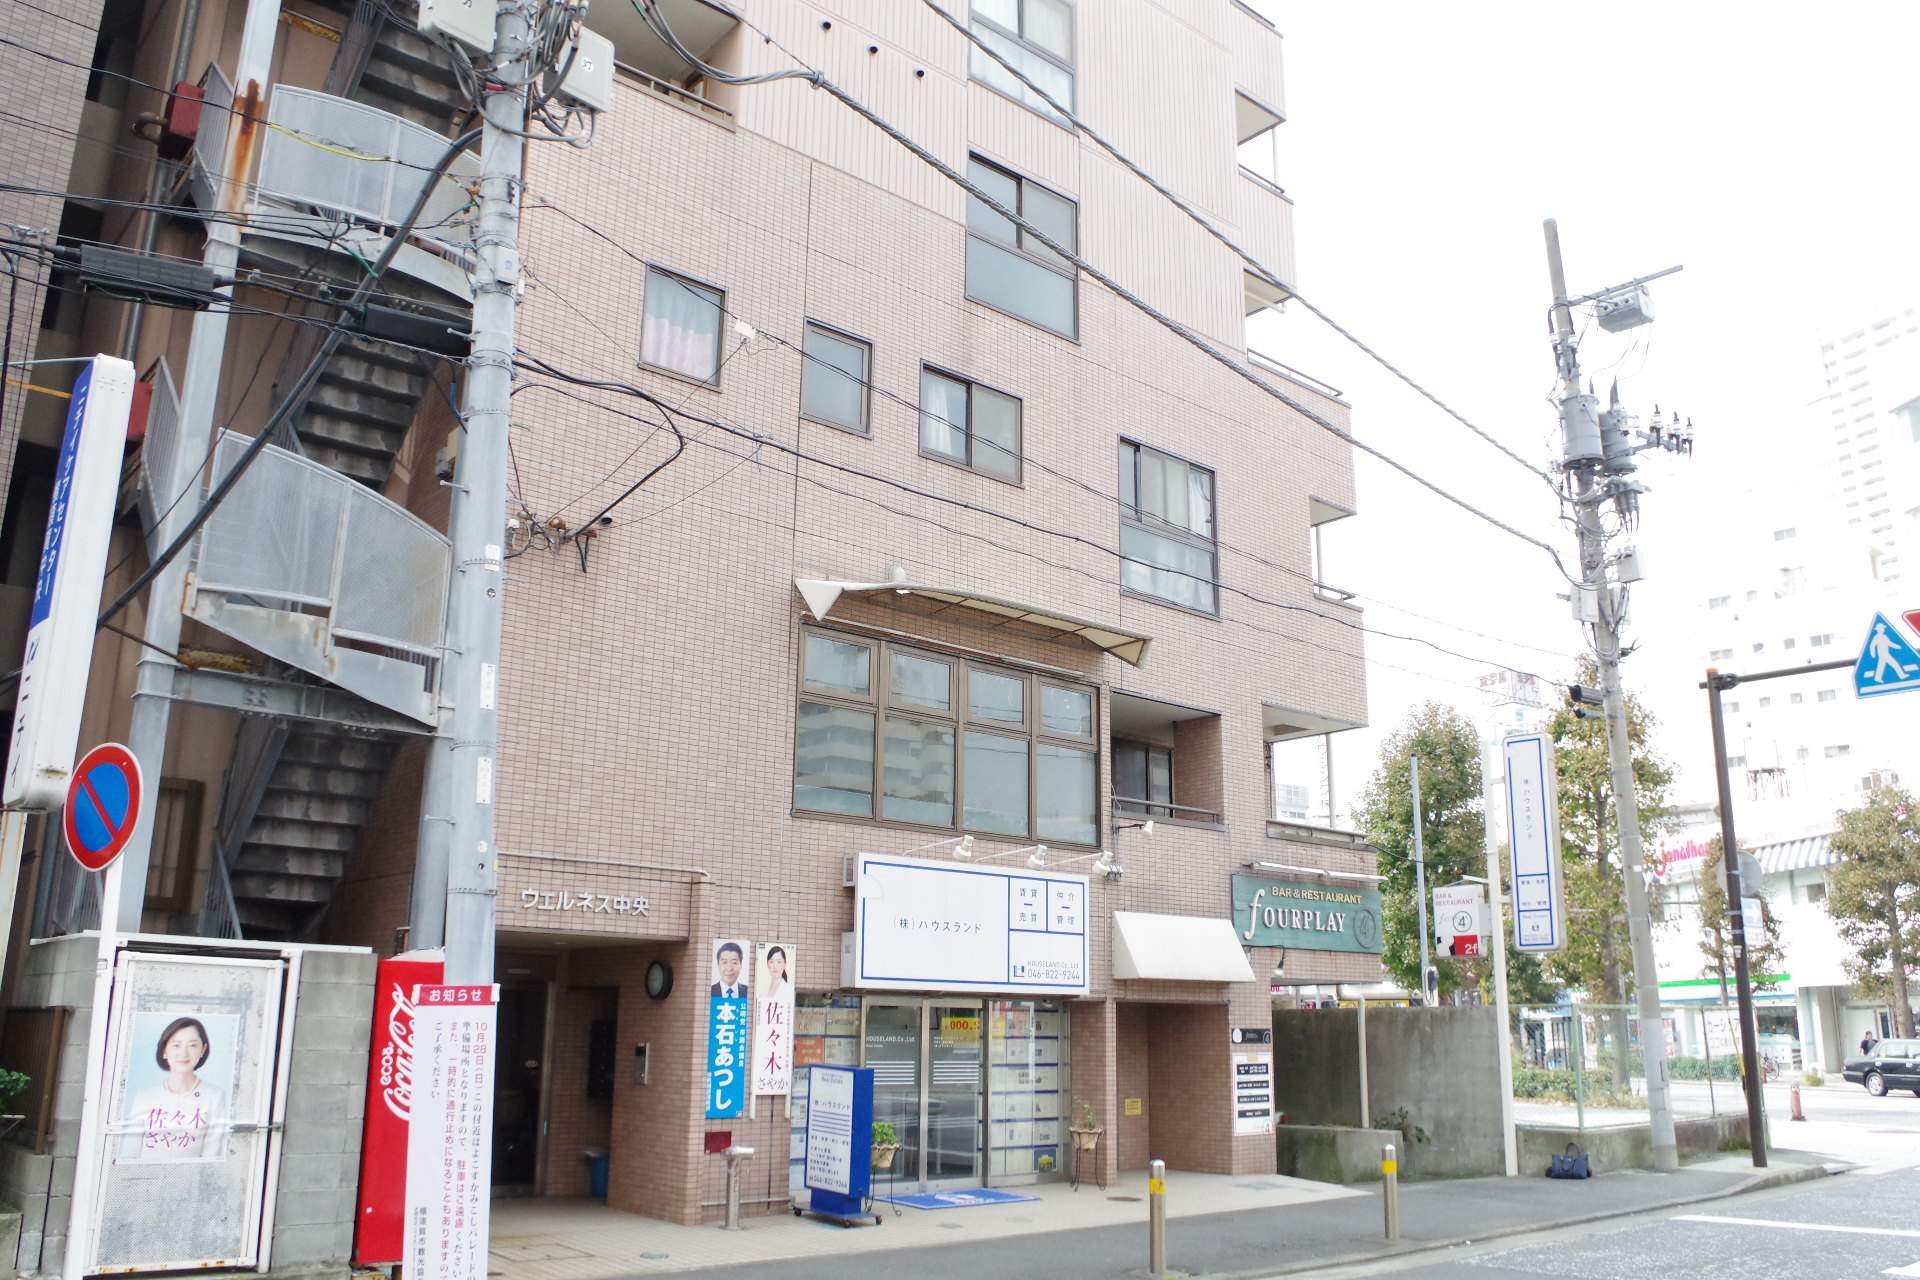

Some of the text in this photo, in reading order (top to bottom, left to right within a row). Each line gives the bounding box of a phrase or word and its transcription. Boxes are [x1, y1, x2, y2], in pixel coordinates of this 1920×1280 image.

[429, 989, 482, 1002] お知らせ
[764, 1001, 784, 1075] 佐々木
[713, 1002, 736, 1111] 本石あつし
[757, 1077, 789, 1091] さやか
[148, 1107, 210, 1130] 佐々木
[144, 1131, 197, 1149] さやか
